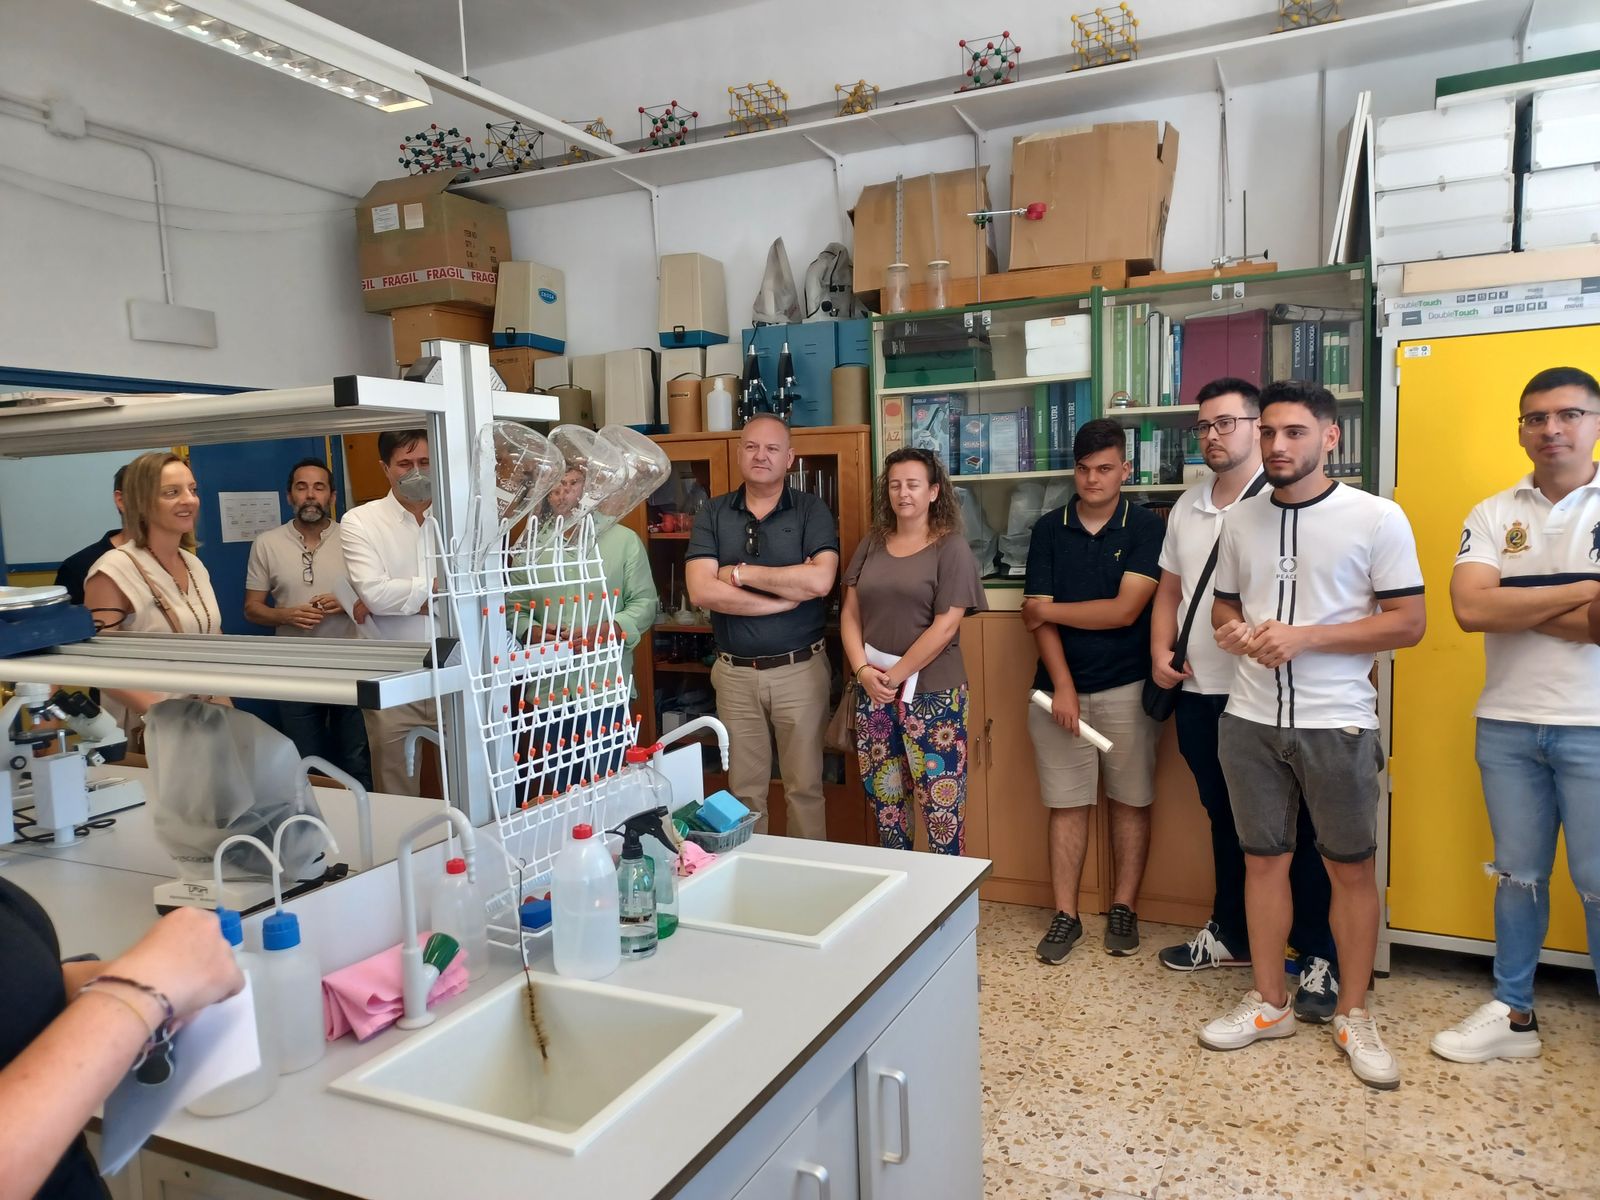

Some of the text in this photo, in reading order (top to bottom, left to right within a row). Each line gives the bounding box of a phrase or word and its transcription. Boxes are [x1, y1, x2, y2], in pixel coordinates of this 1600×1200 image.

[382, 272, 418, 287] FRAGIL
[426, 267, 464, 280] FRAGIL
[471, 271, 497, 283] FRAGI
[1428, 308, 1479, 320] DoubleTouch
[1457, 528, 1472, 557] 2
[1511, 531, 1521, 544] 2
